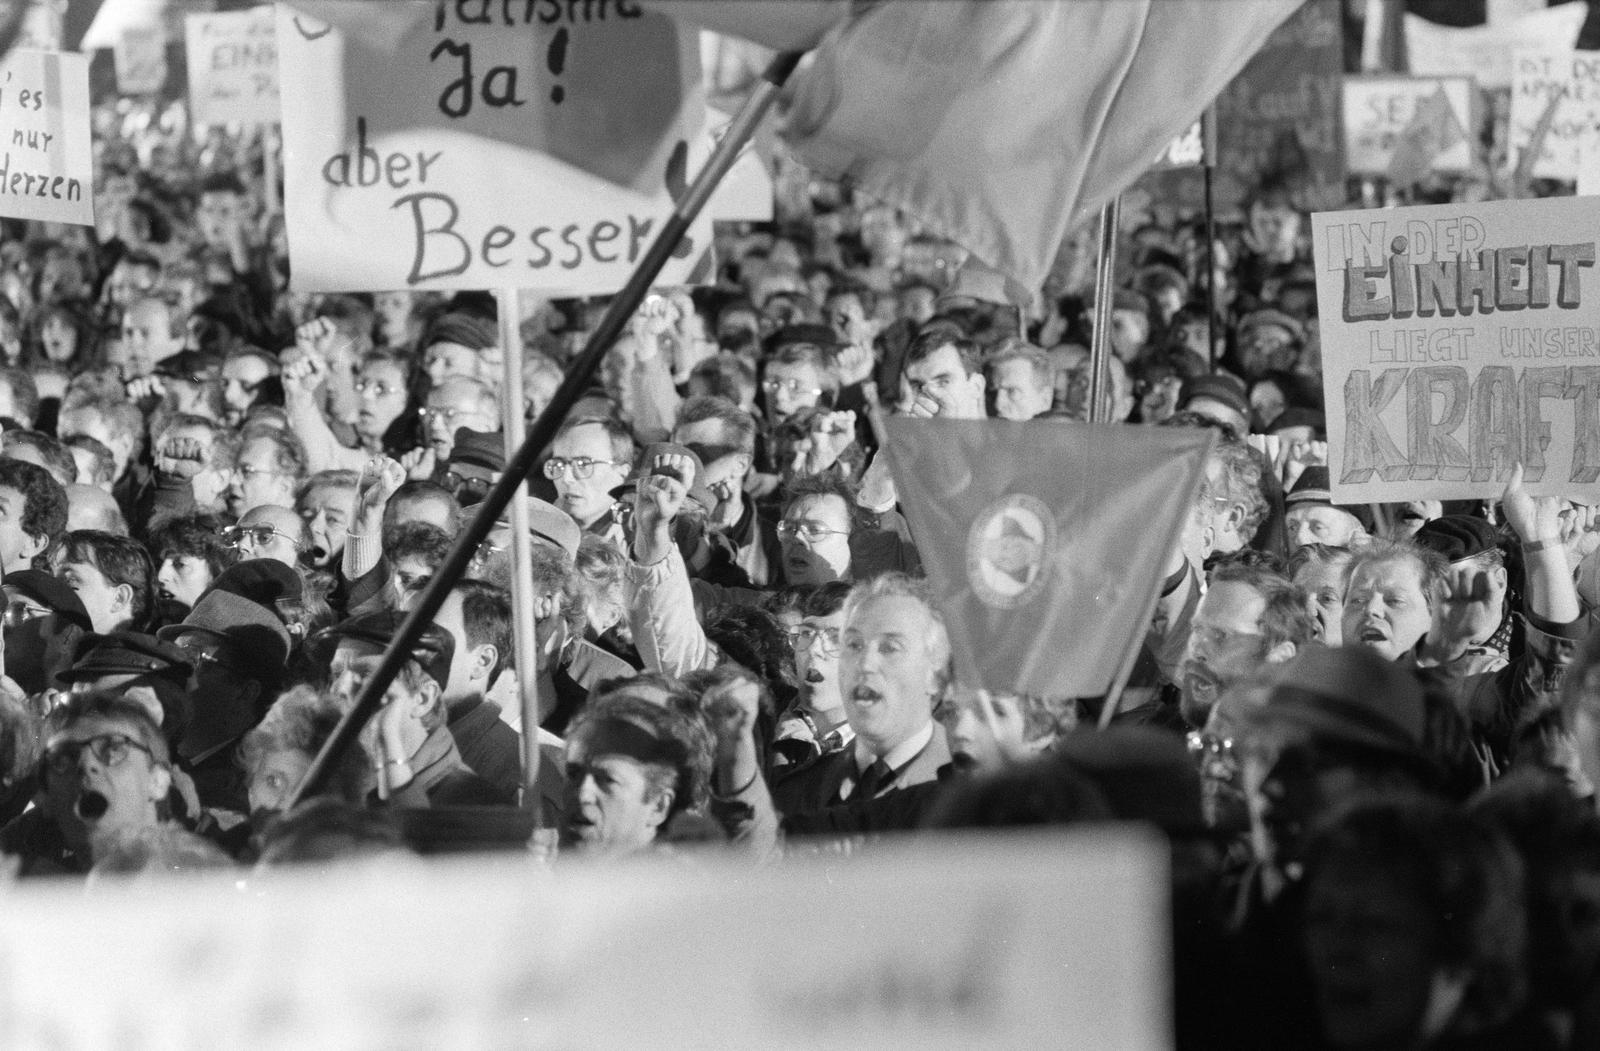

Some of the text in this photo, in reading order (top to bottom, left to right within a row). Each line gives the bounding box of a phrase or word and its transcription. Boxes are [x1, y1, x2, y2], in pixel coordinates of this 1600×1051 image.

[18, 87, 43, 111] es
[12, 127, 53, 152] nur
[322, 117, 443, 188] aber
[1326, 216, 1486, 271] IN DER
[1369, 327, 1475, 363] LIEGT
